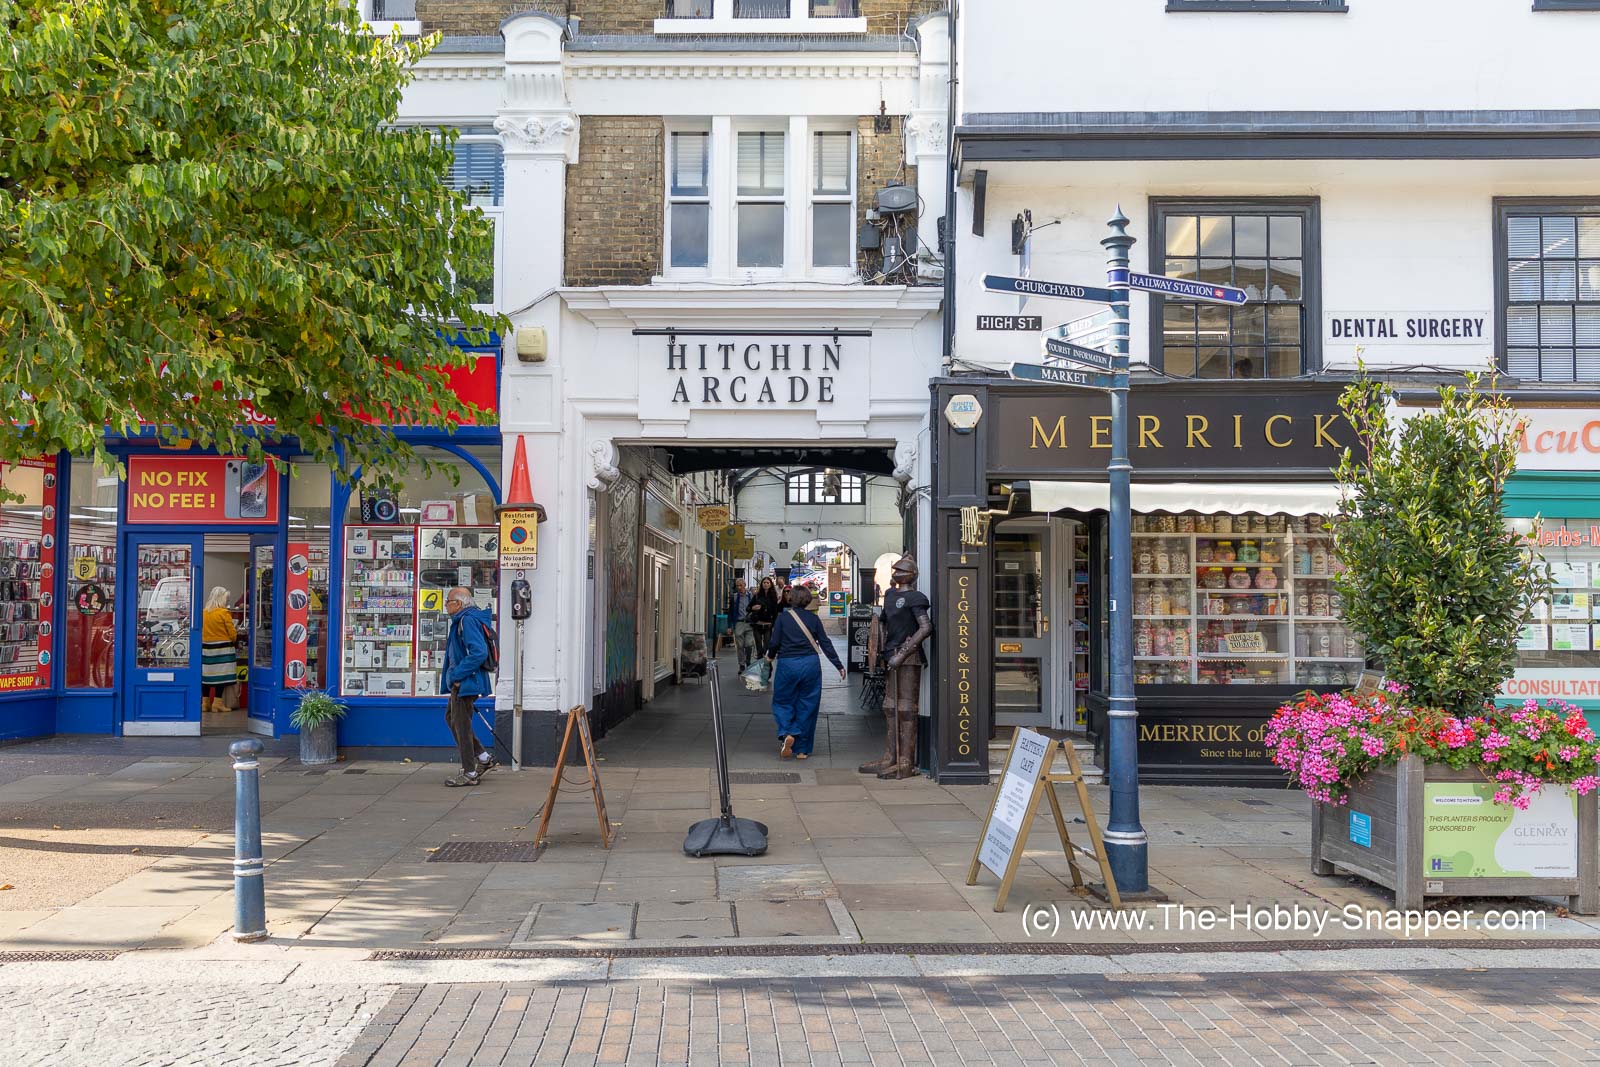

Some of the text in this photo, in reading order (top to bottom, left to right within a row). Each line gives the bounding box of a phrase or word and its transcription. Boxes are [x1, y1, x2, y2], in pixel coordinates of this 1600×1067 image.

[1014, 280, 1085, 298] CHURCHYARD
[1131, 275, 1213, 297] RAILWAY STATION
[980, 317, 1039, 329] HIGH ST.
[1331, 318, 1484, 338] DENTAL SURGERY
[666, 343, 842, 370] HITCHIN
[1047, 342, 1108, 364] TOURIST INFORMATION
[1041, 368, 1088, 384] MARKET
[671, 376, 835, 403] ARCADE
[1030, 414, 1342, 449] MERRICK
[141, 471, 208, 487] NO FIX
[133, 493, 215, 508] NO FEE !
[957, 576, 970, 755] CIGARS & TOBACCO
[17, 676, 34, 687] SHOP
[1139, 724, 1268, 742] MERRICK of
[1200, 748, 1224, 758] Since
[1227, 748, 1242, 758] the
[1245, 748, 1261, 758] late
[1513, 827, 1568, 837] GLENRAY
